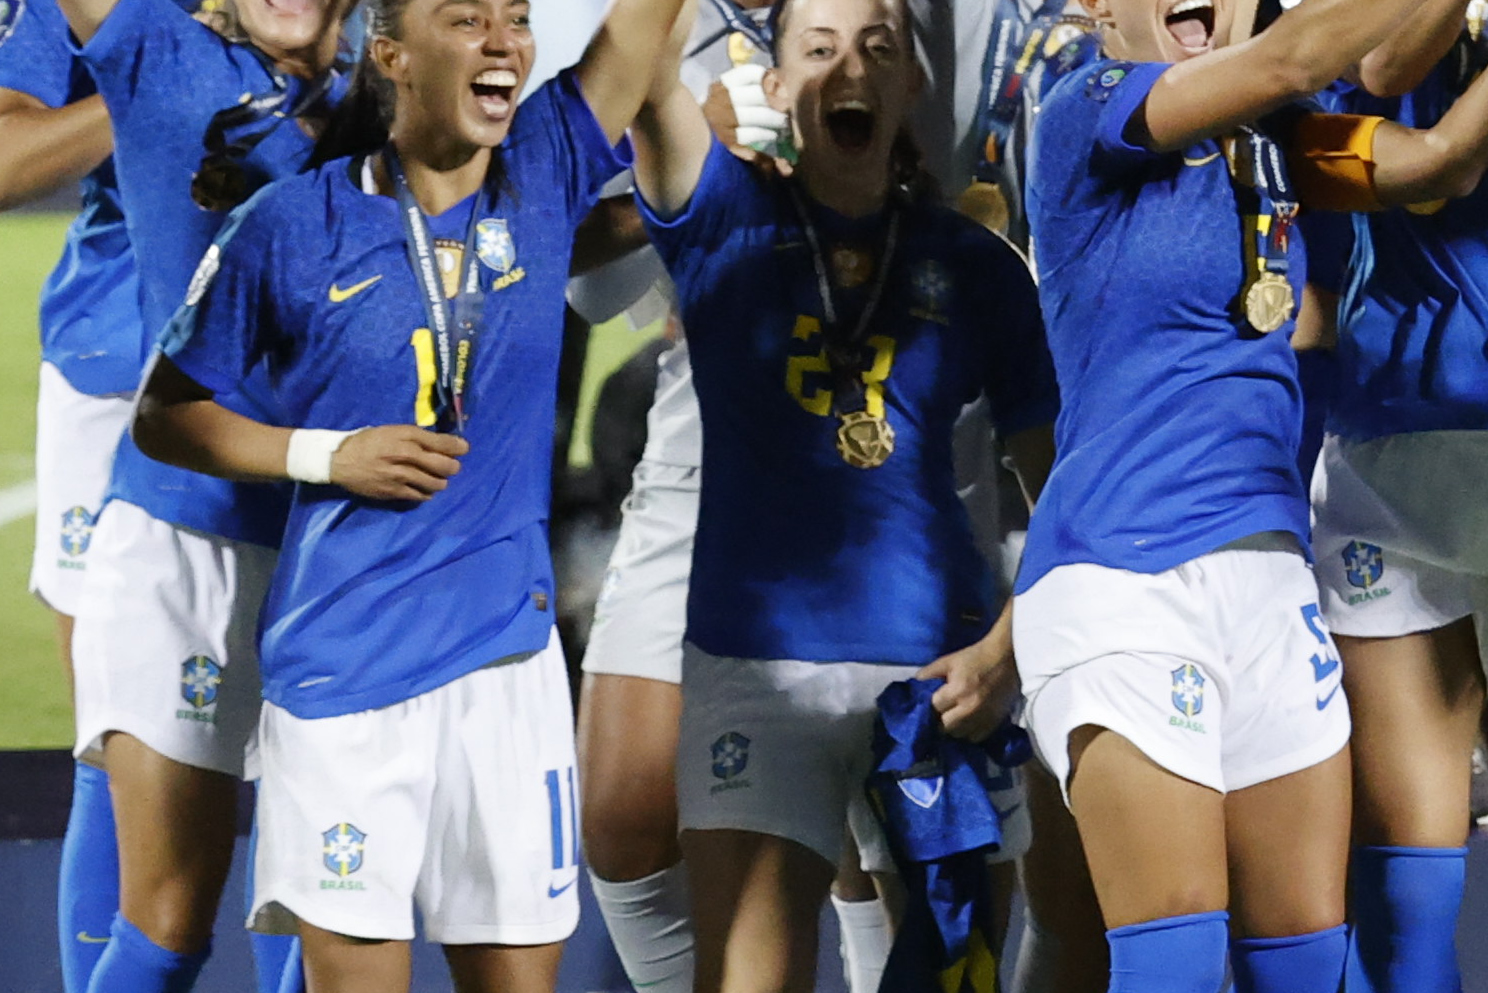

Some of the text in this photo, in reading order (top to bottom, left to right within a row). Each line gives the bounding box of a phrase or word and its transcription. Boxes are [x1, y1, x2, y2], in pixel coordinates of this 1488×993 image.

[408, 206, 429, 257] FEMENINA
[420, 257, 442, 303] AMERICA
[431, 303, 446, 332] COPA
[1348, 586, 1392, 606] BRASIL
[1168, 715, 1208, 735] BRASIL
[319, 879, 367, 892] BRASIL
